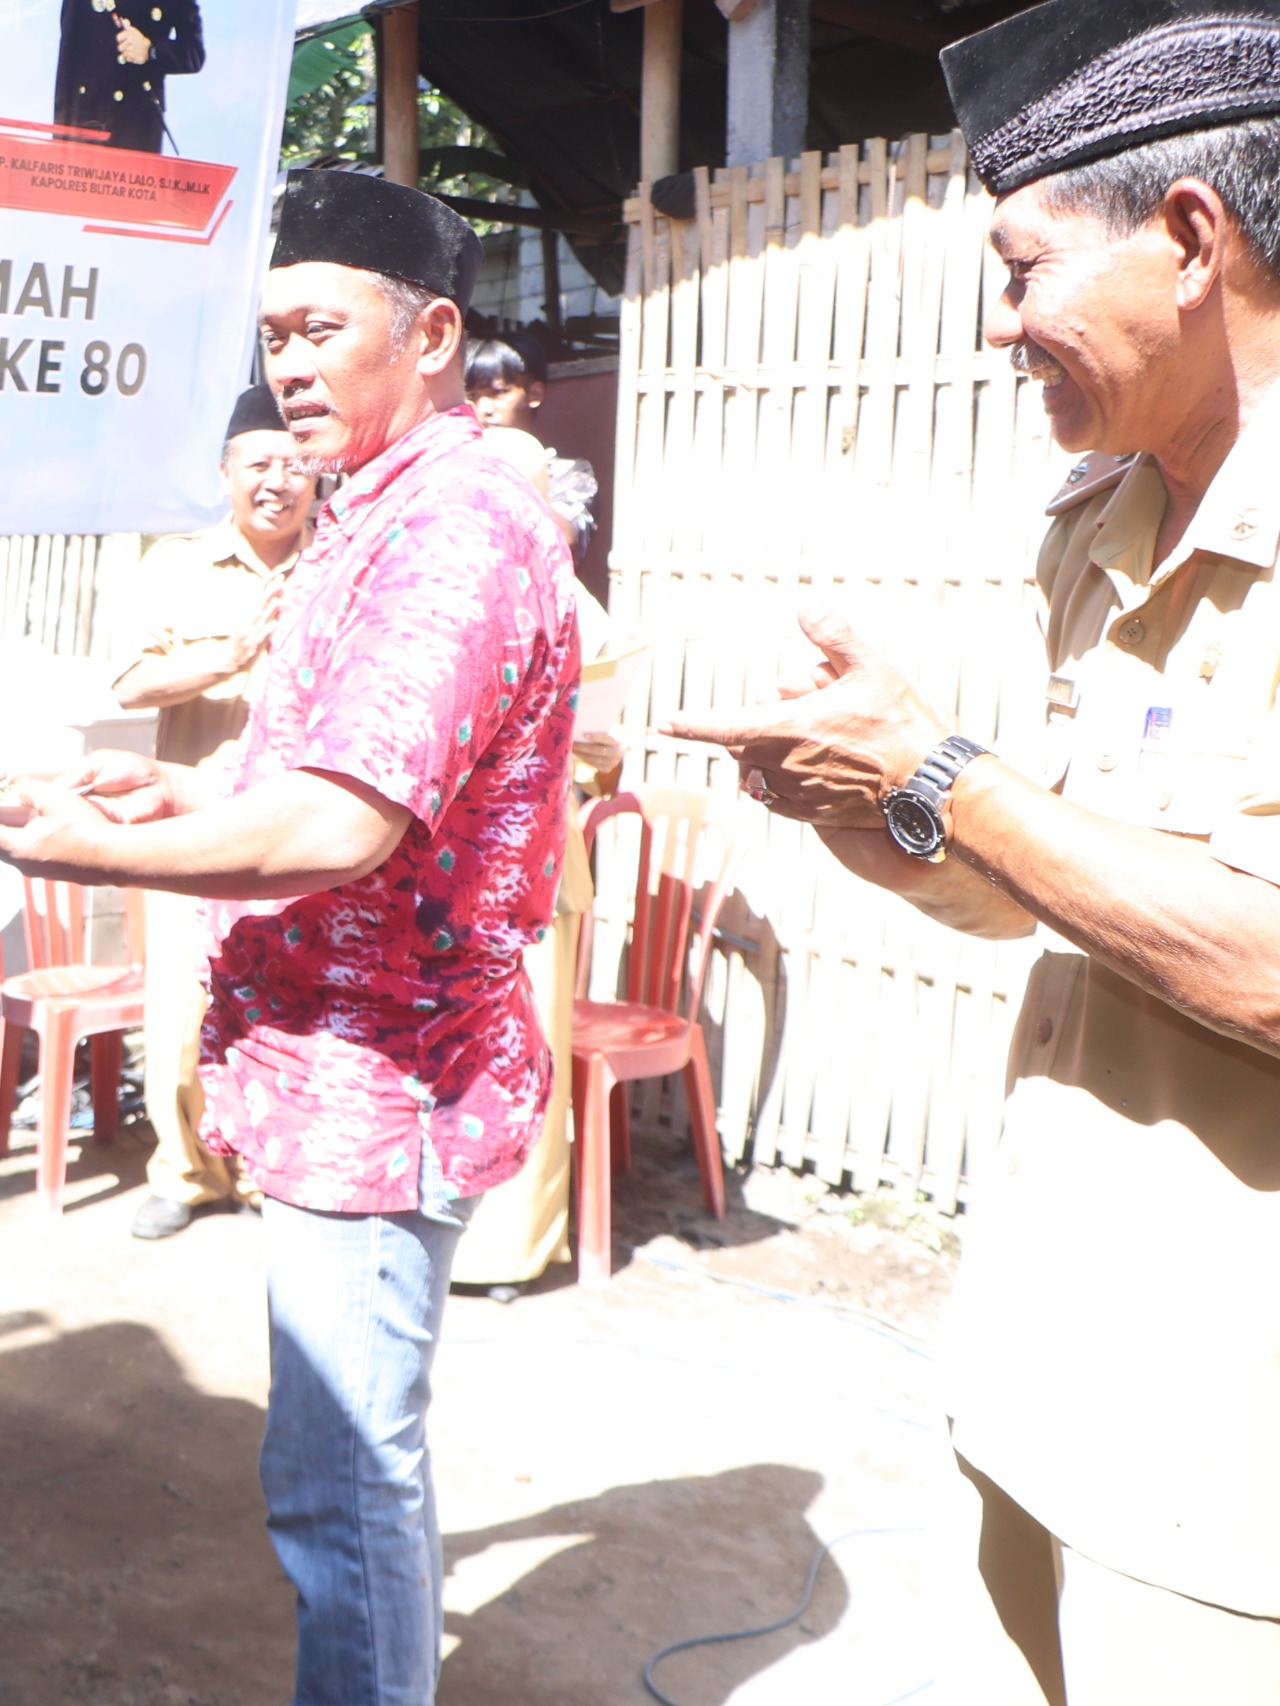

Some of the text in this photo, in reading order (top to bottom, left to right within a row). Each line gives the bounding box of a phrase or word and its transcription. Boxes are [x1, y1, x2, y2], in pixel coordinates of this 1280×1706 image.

[11, 158, 64, 175] KALFARIS
[67, 165, 126, 184] TRIWIJAYA
[129, 173, 156, 189] LALO,
[31, 175, 157, 201] KAPOLRES BLITAR KOTA
[79, 341, 146, 397] 80
